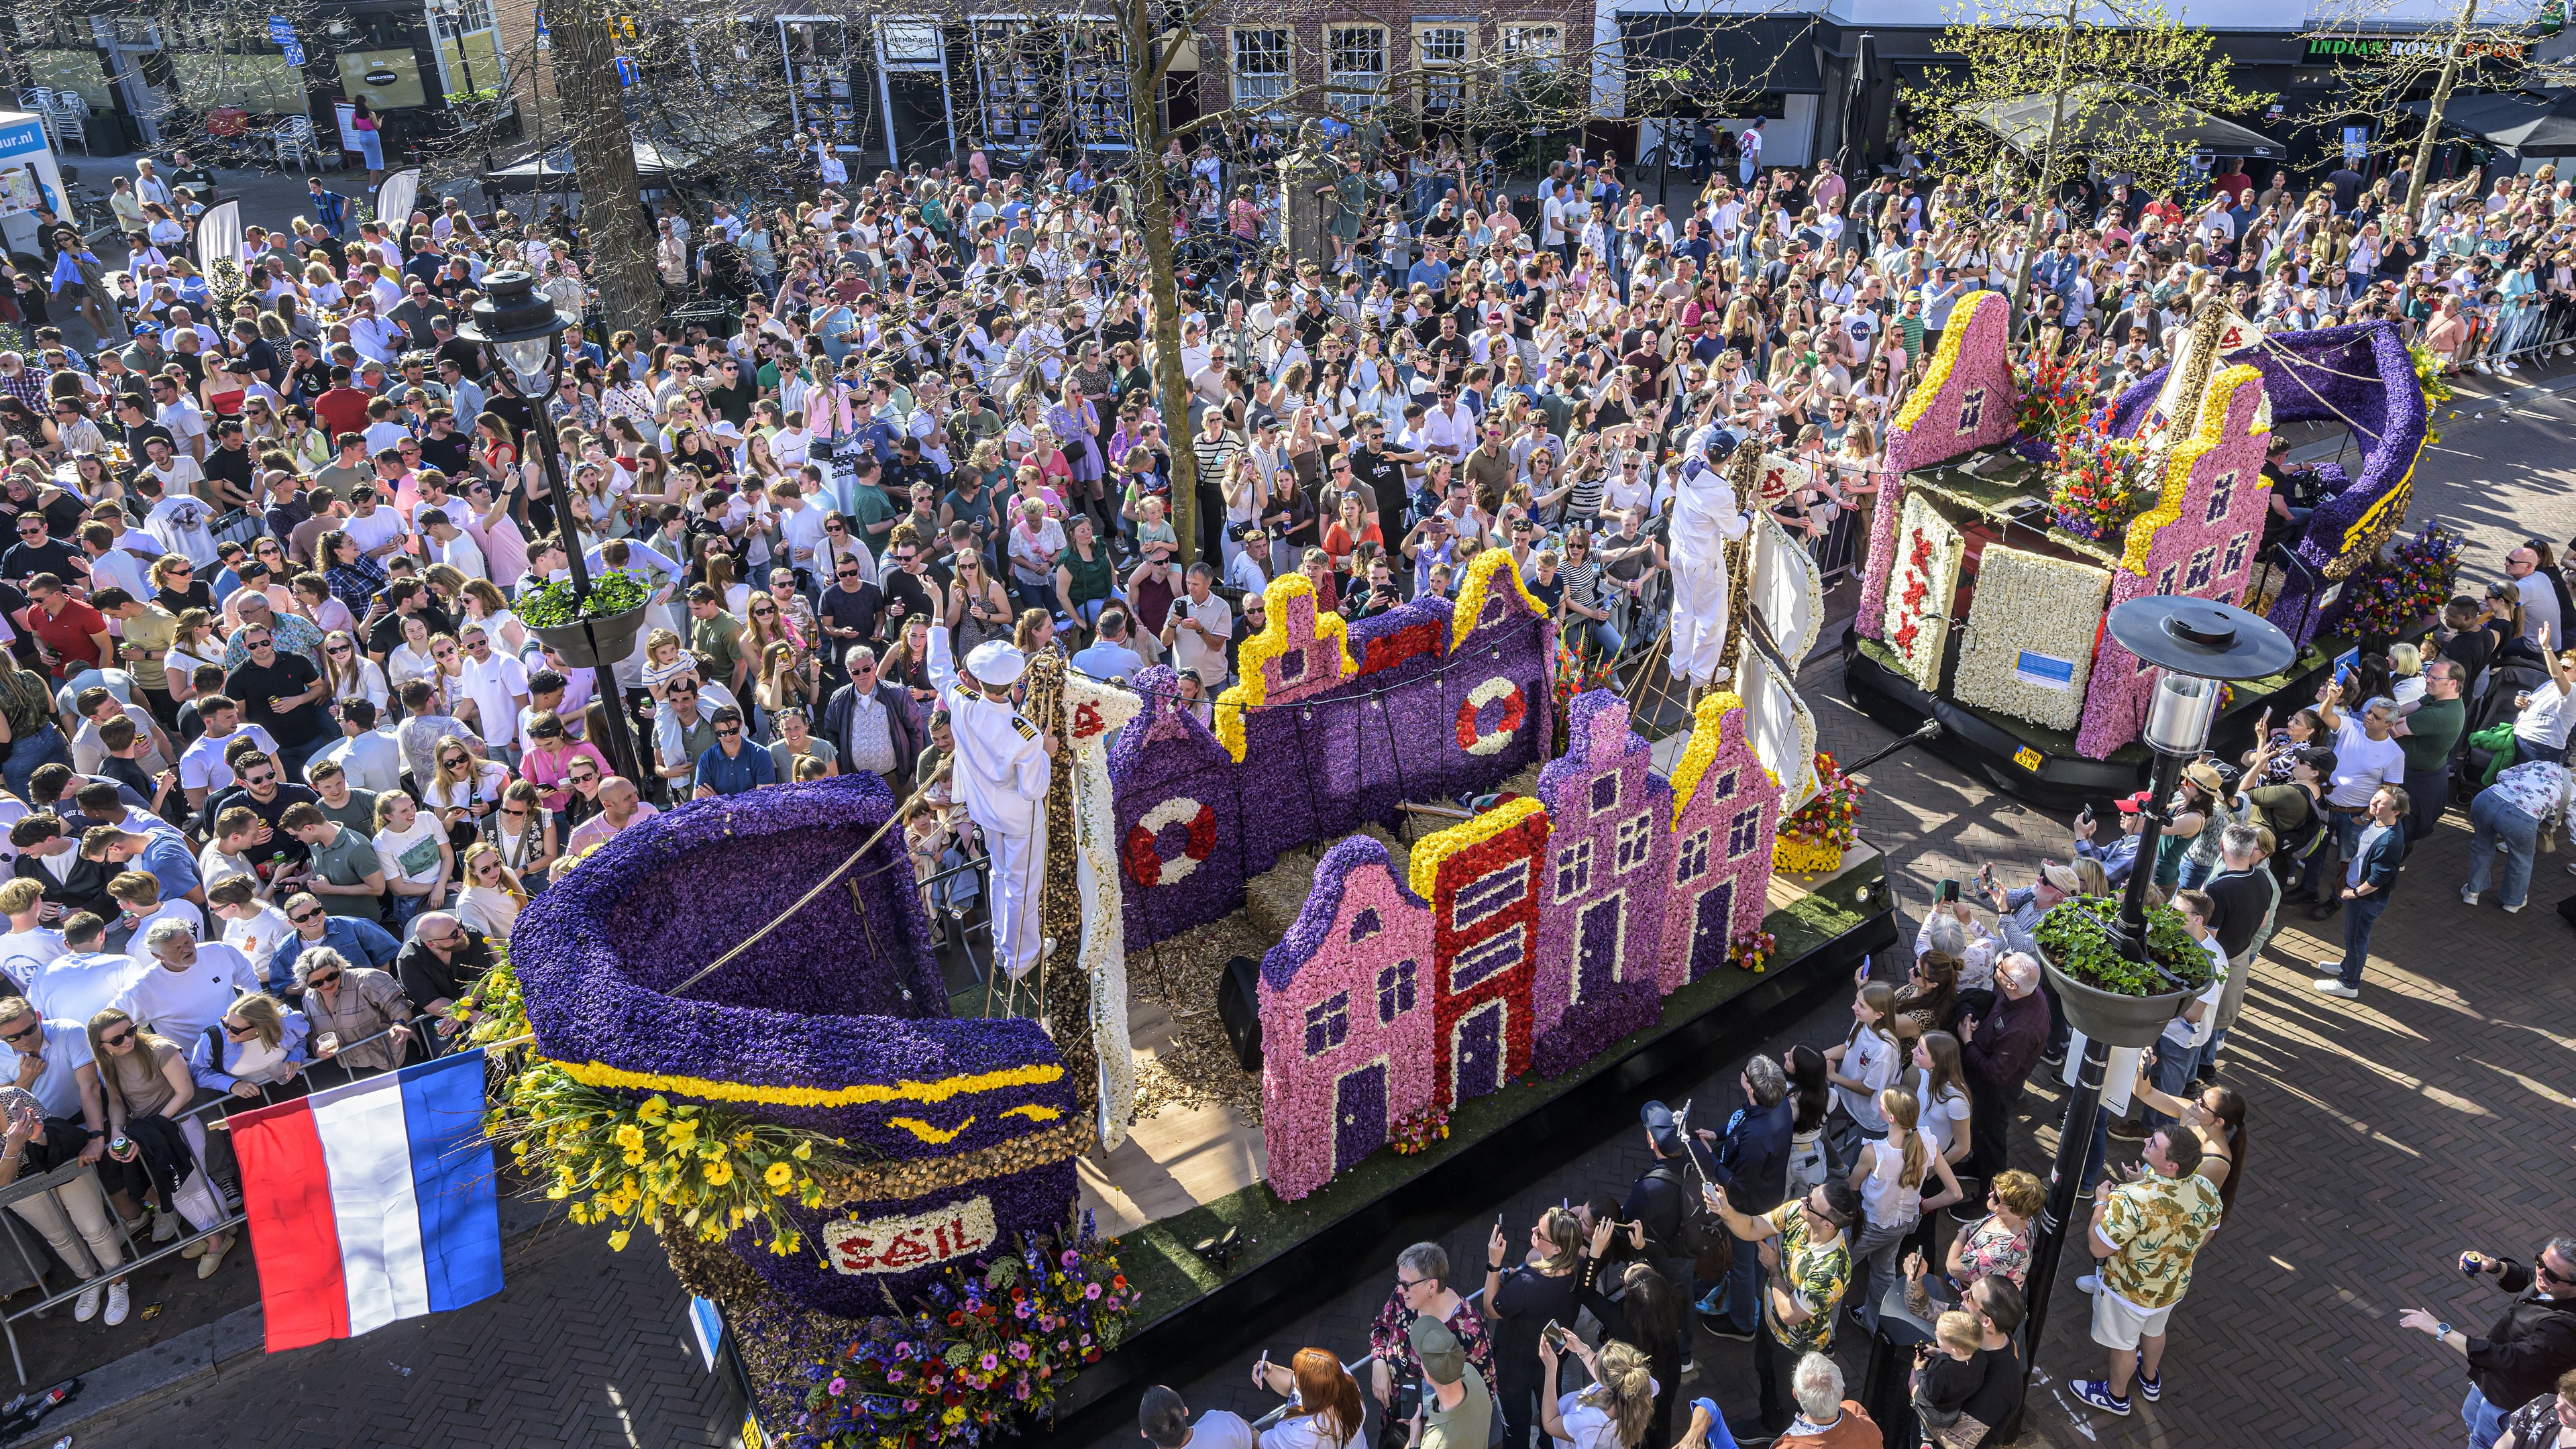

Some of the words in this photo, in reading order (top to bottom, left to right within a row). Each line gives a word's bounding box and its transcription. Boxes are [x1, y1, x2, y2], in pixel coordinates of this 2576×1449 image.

[2309, 40, 2385, 54] INDIAN
[2463, 42, 2523, 58] FOOD
[2023, 749, 2039, 761] LND
[2018, 756, 2035, 769] 63-N
[63, 809, 77, 818] DAILY
